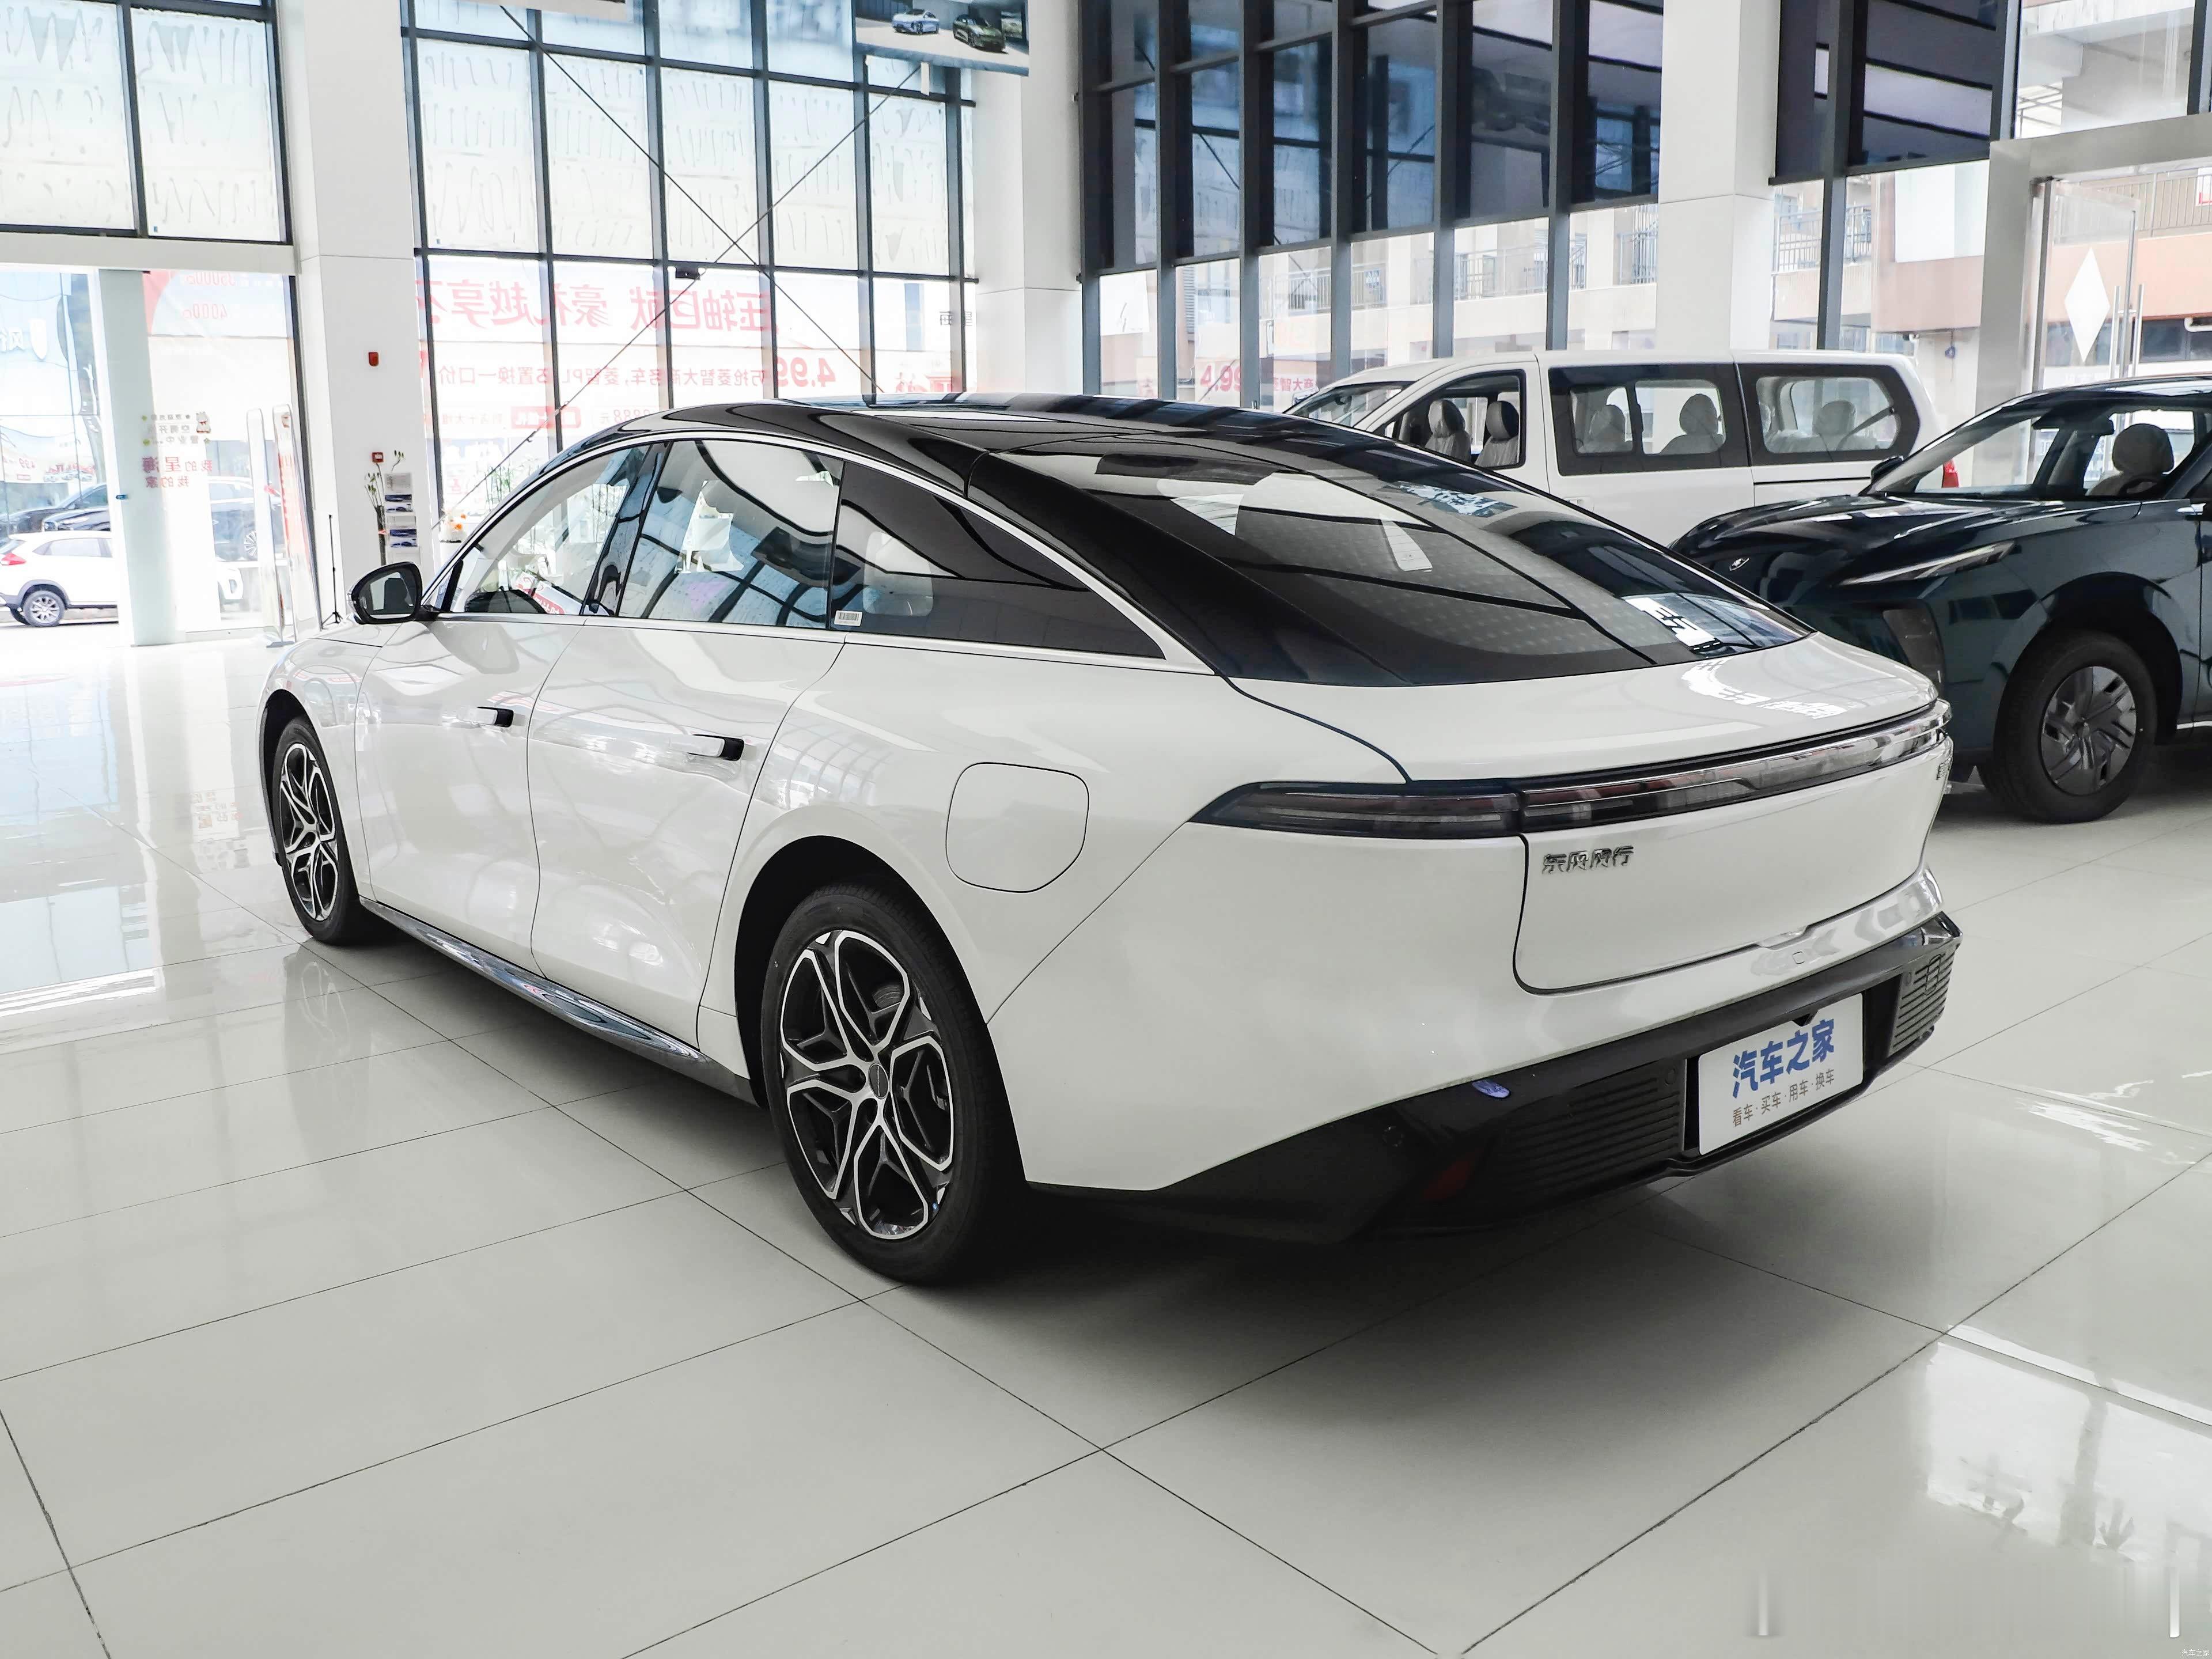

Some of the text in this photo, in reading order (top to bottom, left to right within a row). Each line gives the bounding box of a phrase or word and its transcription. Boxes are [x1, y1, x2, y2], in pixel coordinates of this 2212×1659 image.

[1541, 845, 1634, 874] 东风风行
[1732, 1018, 1835, 1099] 汽车之家
